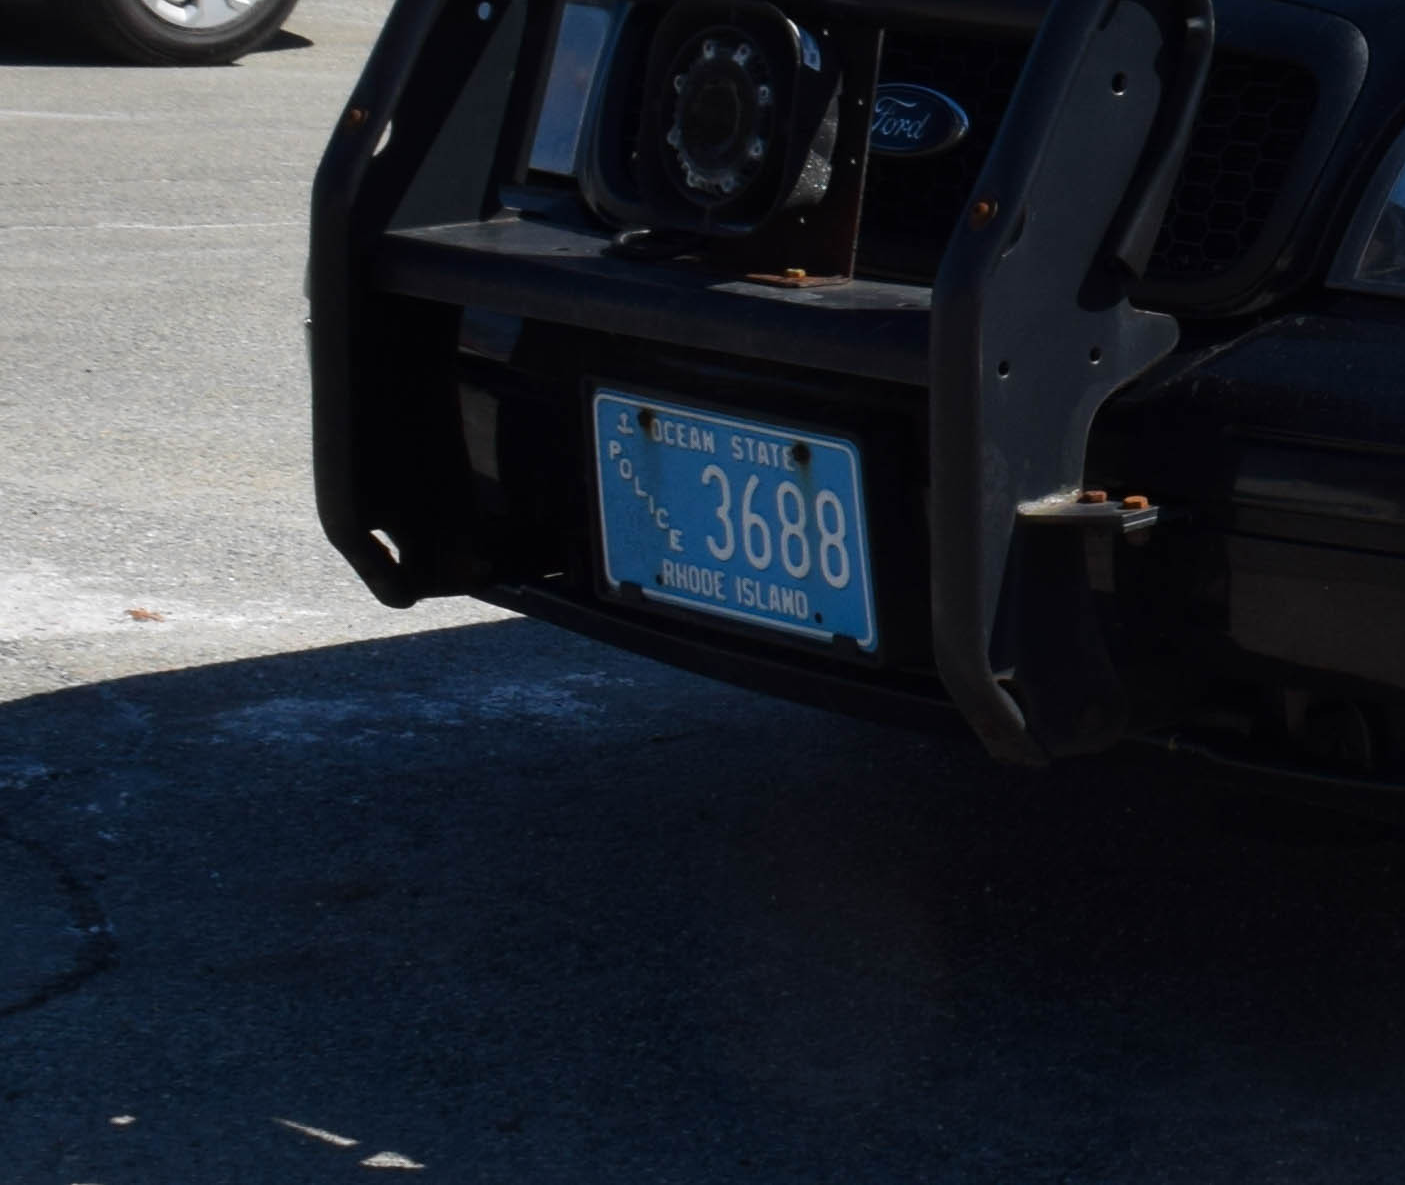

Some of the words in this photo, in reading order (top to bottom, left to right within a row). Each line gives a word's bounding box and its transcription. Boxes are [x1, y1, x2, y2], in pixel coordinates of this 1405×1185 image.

[871, 96, 931, 139] Ford
[651, 418, 715, 453] OCEAN
[731, 435, 795, 471] STATE
[609, 440, 683, 551] POLICE
[702, 464, 850, 589] 3688
[662, 559, 726, 600] RHODE
[735, 576, 808, 619] ISLAND
